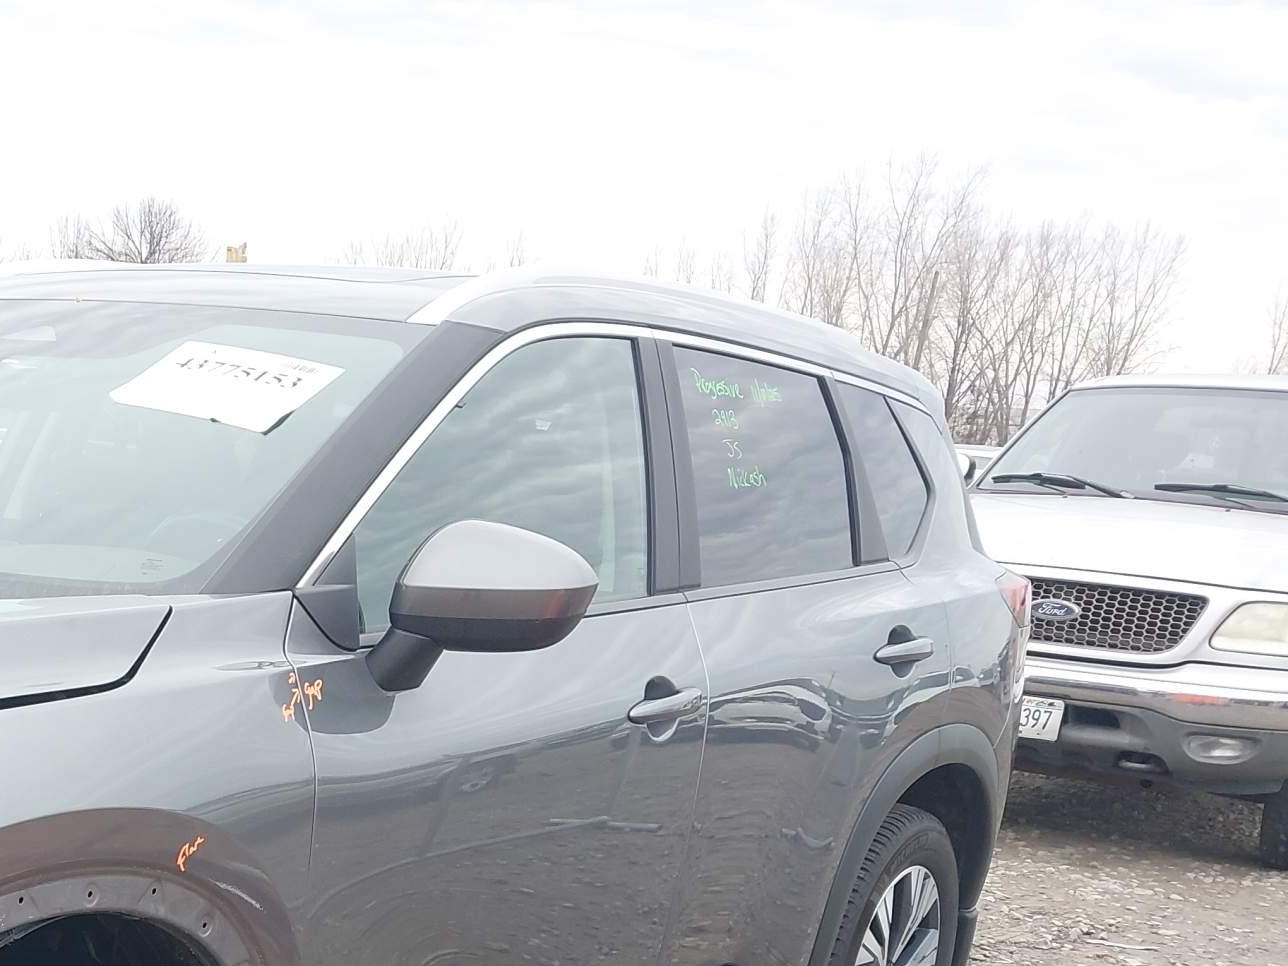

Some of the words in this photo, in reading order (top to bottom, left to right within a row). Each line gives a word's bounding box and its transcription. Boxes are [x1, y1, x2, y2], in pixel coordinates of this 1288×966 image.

[176, 357, 303, 388] 43775153
[1037, 602, 1069, 617] Ford
[1020, 707, 1053, 731] 397
